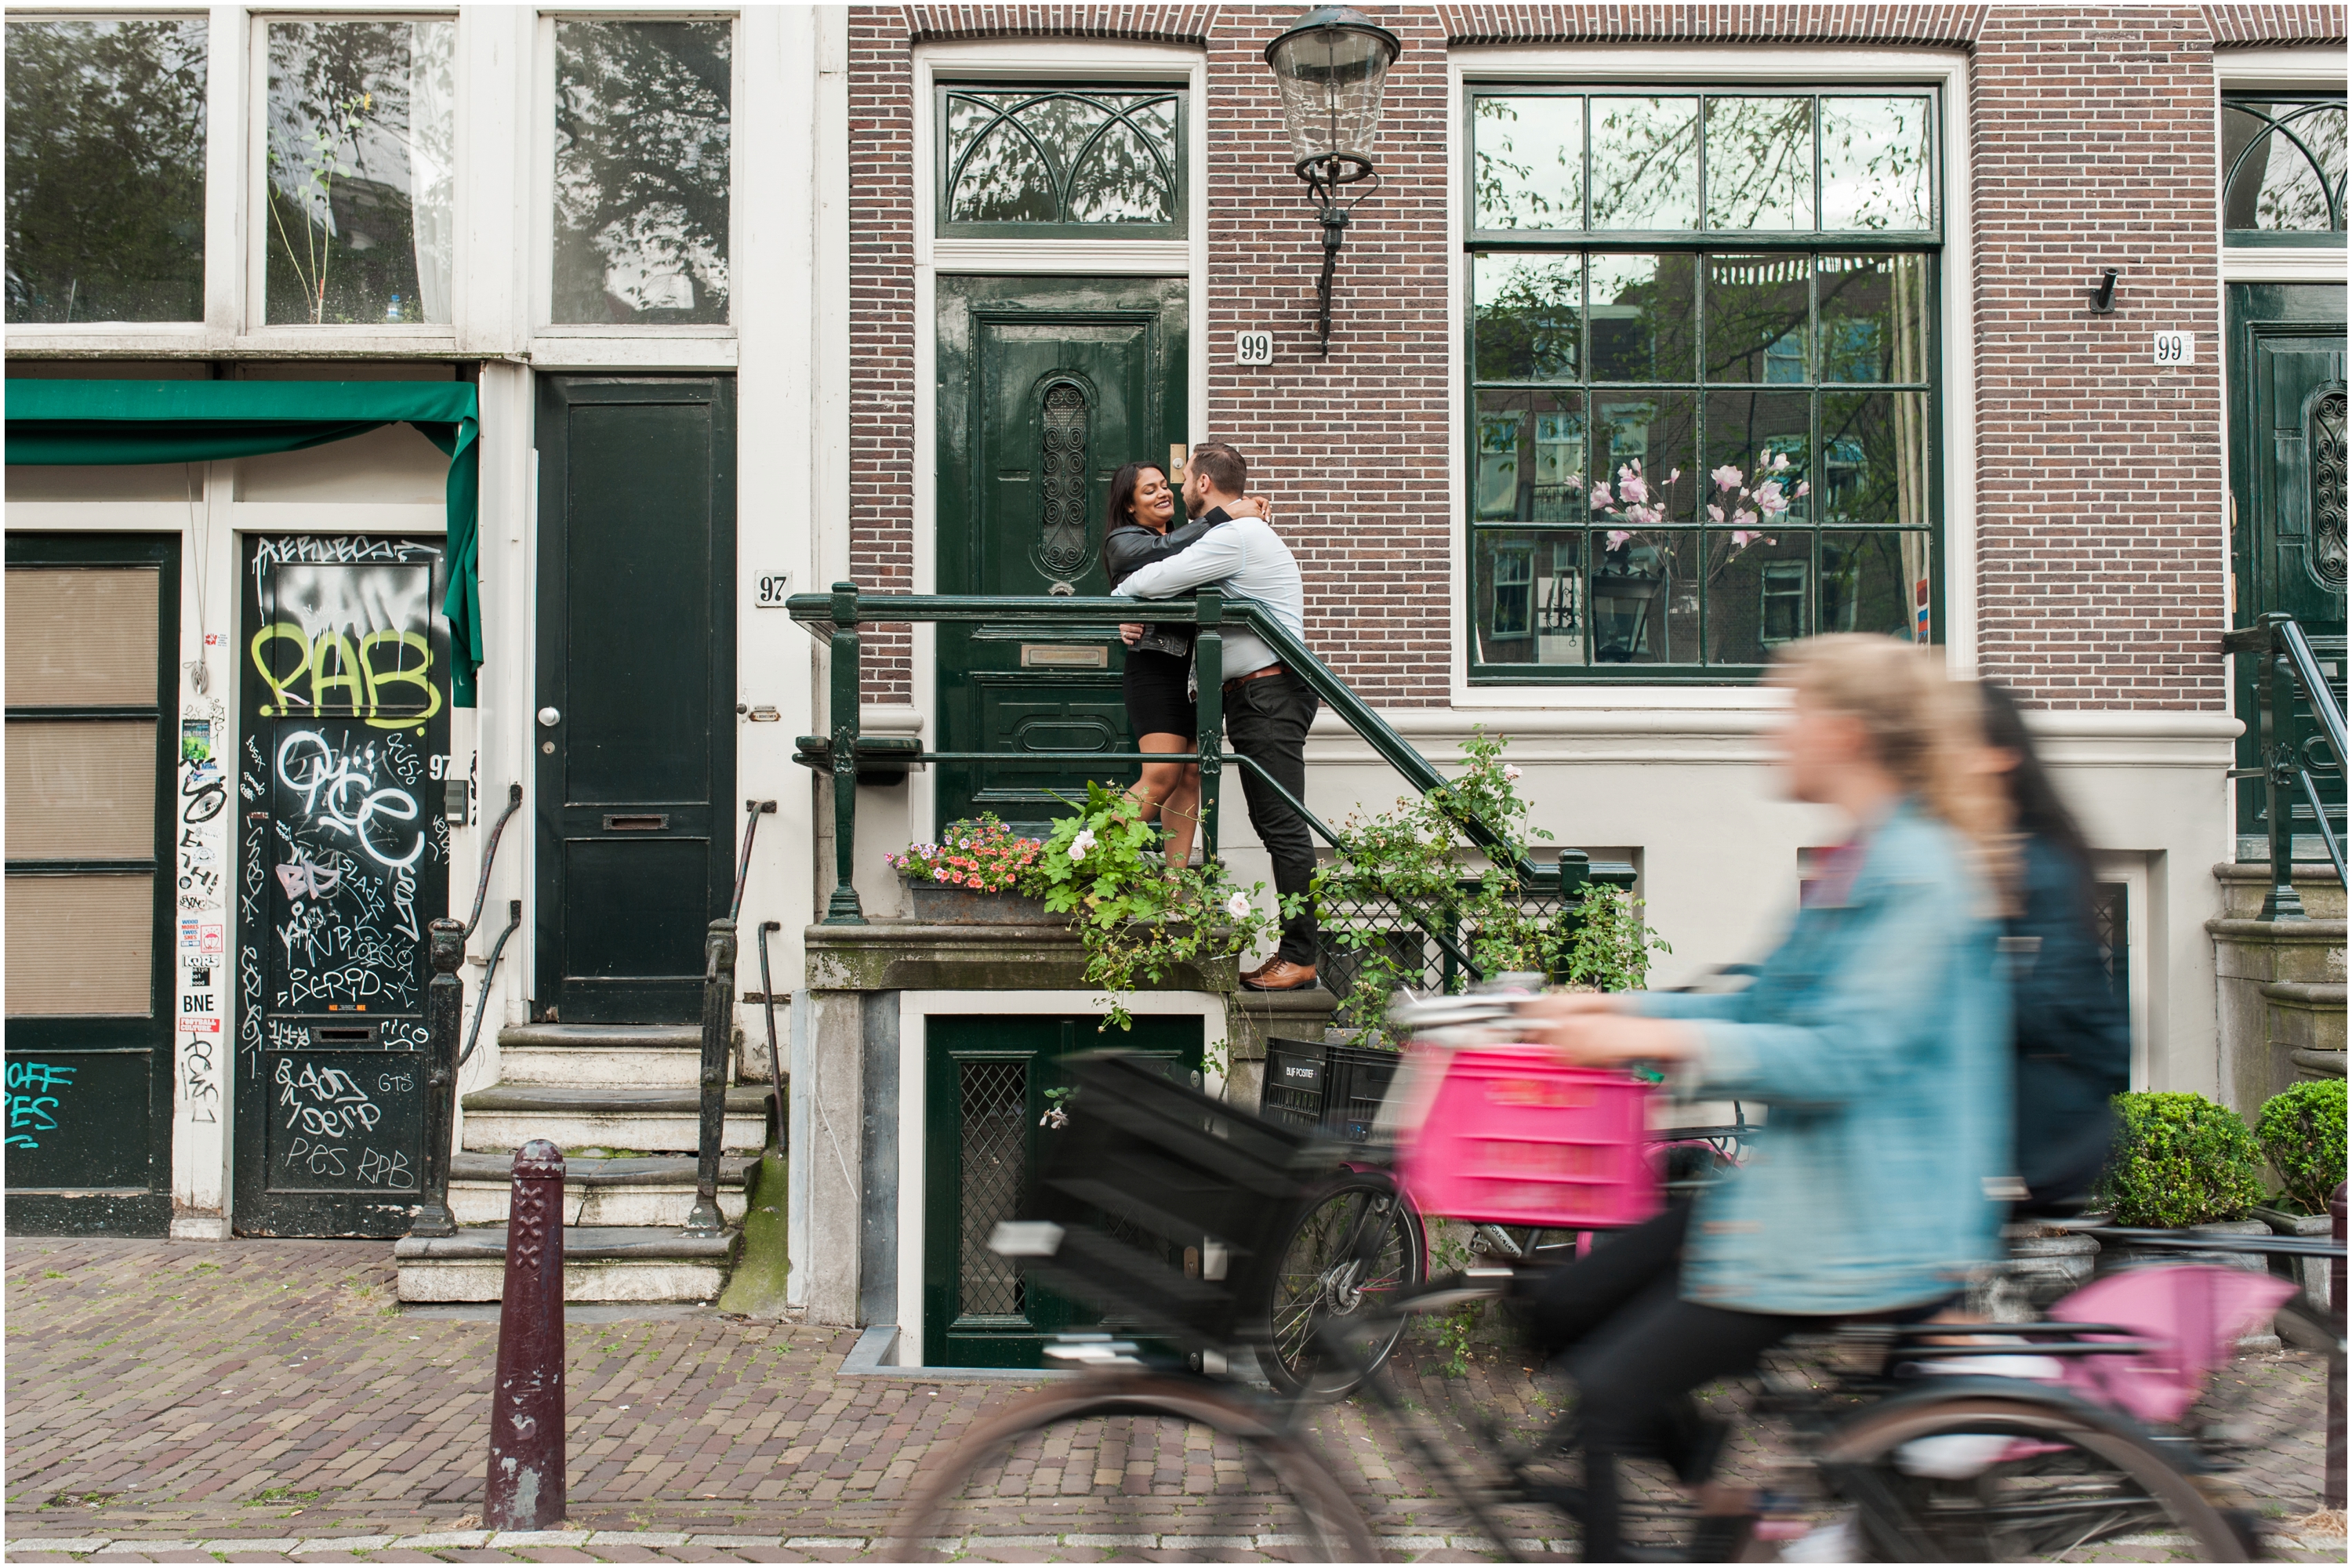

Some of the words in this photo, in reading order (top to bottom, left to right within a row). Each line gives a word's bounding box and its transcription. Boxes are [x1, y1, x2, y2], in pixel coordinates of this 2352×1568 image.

[1242, 336, 1268, 360] 99
[2158, 336, 2182, 361] 99
[760, 577, 786, 601] 97
[430, 755, 451, 781] 97
[183, 955, 220, 967] KORS
[183, 994, 214, 1012] BNE
[5, 1061, 78, 1093] OFF
